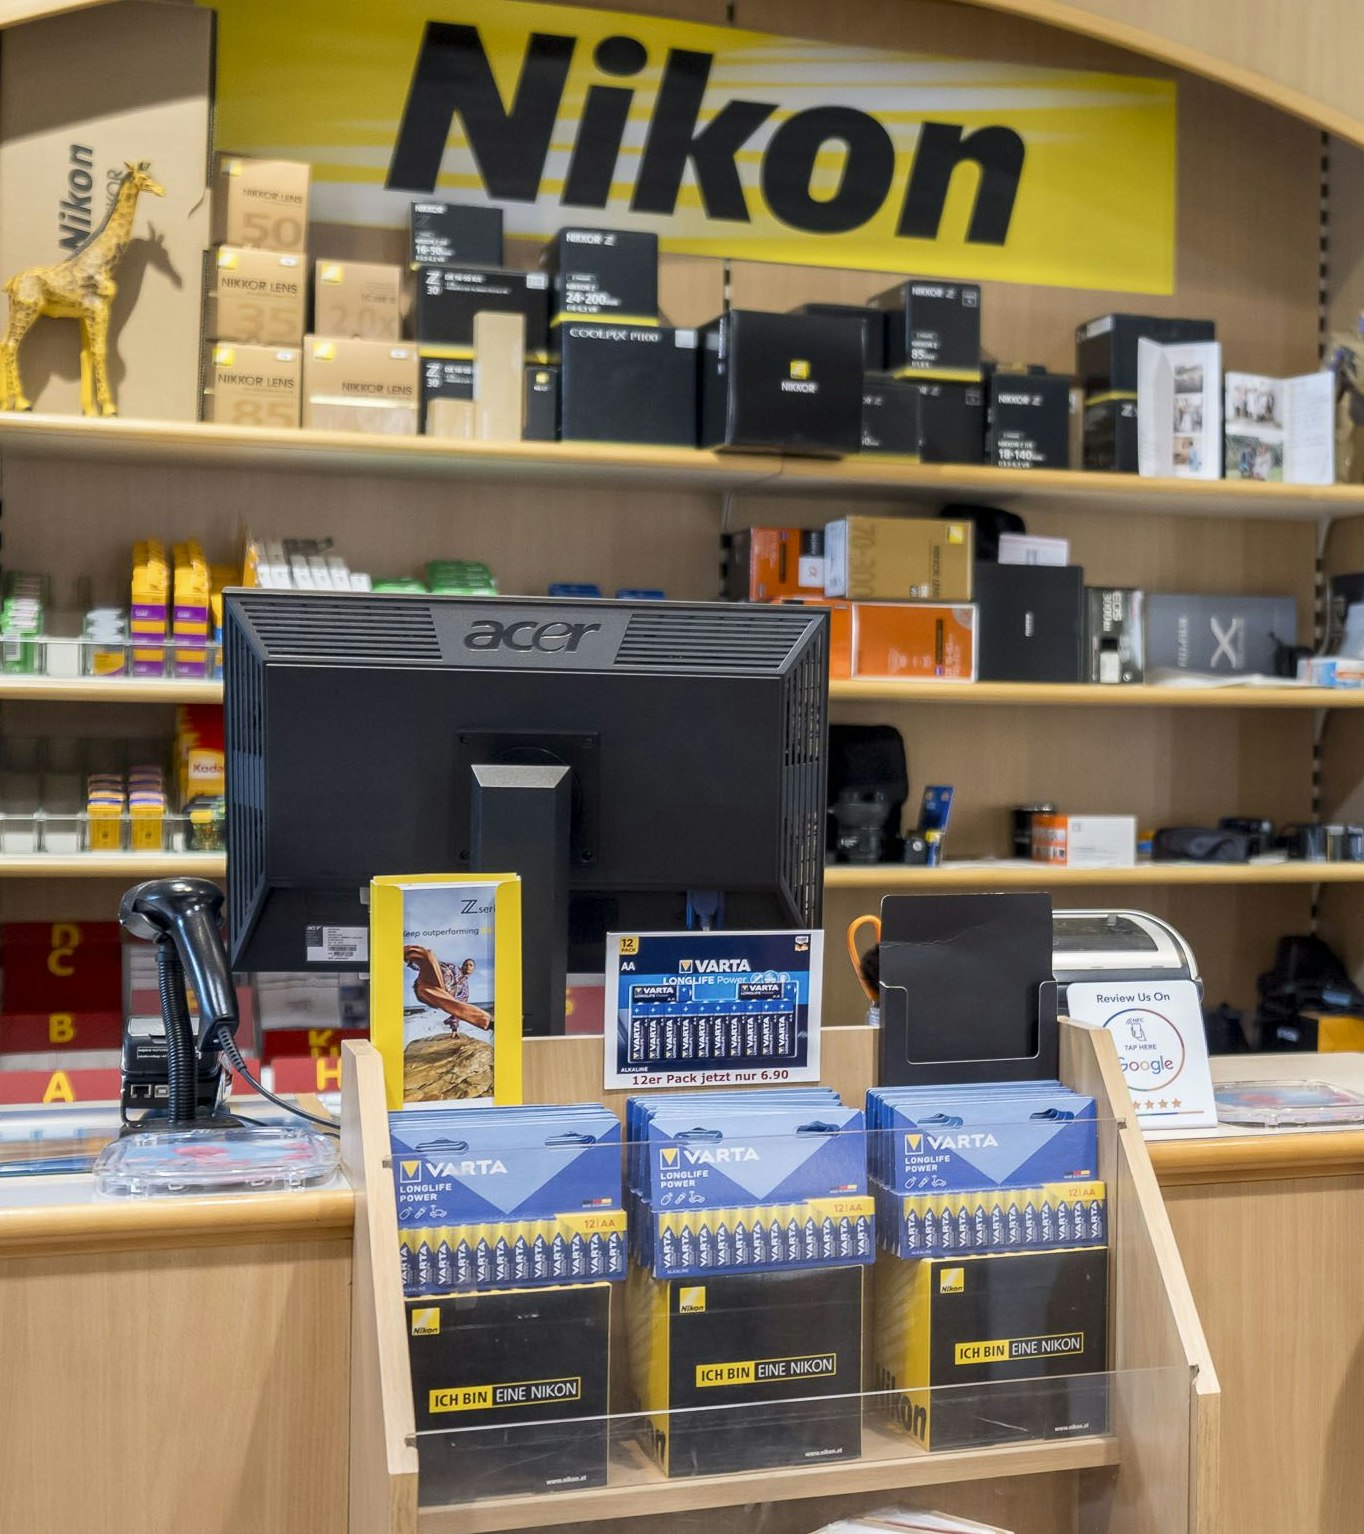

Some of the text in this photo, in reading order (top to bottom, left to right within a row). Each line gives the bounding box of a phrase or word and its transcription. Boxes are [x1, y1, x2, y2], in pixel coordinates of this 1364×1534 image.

[384, 20, 1026, 247] Nikon
[58, 144, 93, 249] Nikon
[242, 188, 303, 204] NIKKOR LENS
[241, 212, 300, 248] 50
[566, 232, 602, 244] NIKKOR
[221, 277, 298, 294] NIKKOR LENS
[912, 287, 943, 298] NIKKOR
[569, 328, 626, 341] COOLPIX
[217, 374, 294, 389] NIKKOR LENS
[342, 381, 412, 396] NIKKOR LENS
[781, 381, 818, 393] NIKKOR
[231, 400, 294, 427] 85
[998, 394, 1029, 405] NIKKOR
[463, 614, 602, 655] acer
[193, 762, 224, 773] Koda
[479, 904, 495, 913] seri
[51, 923, 81, 949] D
[423, 928, 479, 937] outperforming
[621, 938, 634, 948] 12
[48, 949, 76, 977] C
[621, 962, 635, 970] AA
[695, 959, 751, 973] VARTA
[663, 975, 747, 985] LONGLIFE Power
[1096, 992, 1170, 1003] Review Us On
[50, 1013, 76, 1044] B
[43, 1071, 77, 1104] A
[633, 1070, 789, 1085] 12er Pack jetzt nur 6.90
[684, 1147, 760, 1164] VARTA
[927, 1133, 999, 1150] VARTA
[426, 1159, 508, 1178] VARTA
[905, 1155, 950, 1164] LONGLIFE
[905, 1164, 938, 1173] POWER
[400, 1183, 452, 1193] LONGLIFE
[660, 1170, 709, 1180] LONGLIFE
[660, 1180, 695, 1188] POWER
[400, 1194, 437, 1202] POWER
[834, 1203, 862, 1212] 12 AA
[584, 1218, 615, 1229] 12 AA
[909, 1212, 917, 1249] VARTA
[925, 1211, 933, 1248] VARTA
[942, 1210, 950, 1247] VARTA
[959, 1209, 967, 1246] VARTA
[976, 1208, 984, 1246] VARTA
[993, 1207, 1001, 1245] VARTA
[1009, 1206, 1017, 1244] VARTA
[1042, 1204, 1050, 1241] VARTA
[1091, 1201, 1099, 1238] VARTA
[663, 1229, 672, 1268] VARTA
[681, 1228, 690, 1267] VARTA
[699, 1227, 708, 1267] VARTA
[717, 1226, 726, 1265] VARTA
[735, 1225, 743, 1264] VARTA
[753, 1223, 761, 1263] VARTA
[771, 1222, 779, 1262] VARTA
[788, 1221, 797, 1261] VARTA
[823, 1219, 831, 1258] VARTA
[840, 1218, 848, 1256] VARTA
[857, 1217, 865, 1256] VARTA
[419, 1246, 427, 1285] VARTA
[438, 1245, 447, 1285] VARTA
[457, 1243, 467, 1283] VARTA
[477, 1241, 486, 1282] VARTA
[496, 1240, 505, 1281] VARTA
[515, 1238, 524, 1279] VARTA
[534, 1237, 543, 1278] VARTA
[553, 1236, 562, 1277] VARTA
[572, 1235, 581, 1275] VARTA
[590, 1233, 599, 1274] VARTA
[609, 1232, 618, 1273] VARTA
[960, 1337, 1080, 1359] ICH BIN EINE NIKON
[701, 1358, 833, 1382] ICH BIN EINE NIKON
[435, 1382, 577, 1407] ICH BIN EINE NIKON
[1054, 1422, 1089, 1432] www.nikon.at
[805, 1448, 843, 1457] www.nikon.at
[546, 1475, 587, 1485] www.nikon.at
